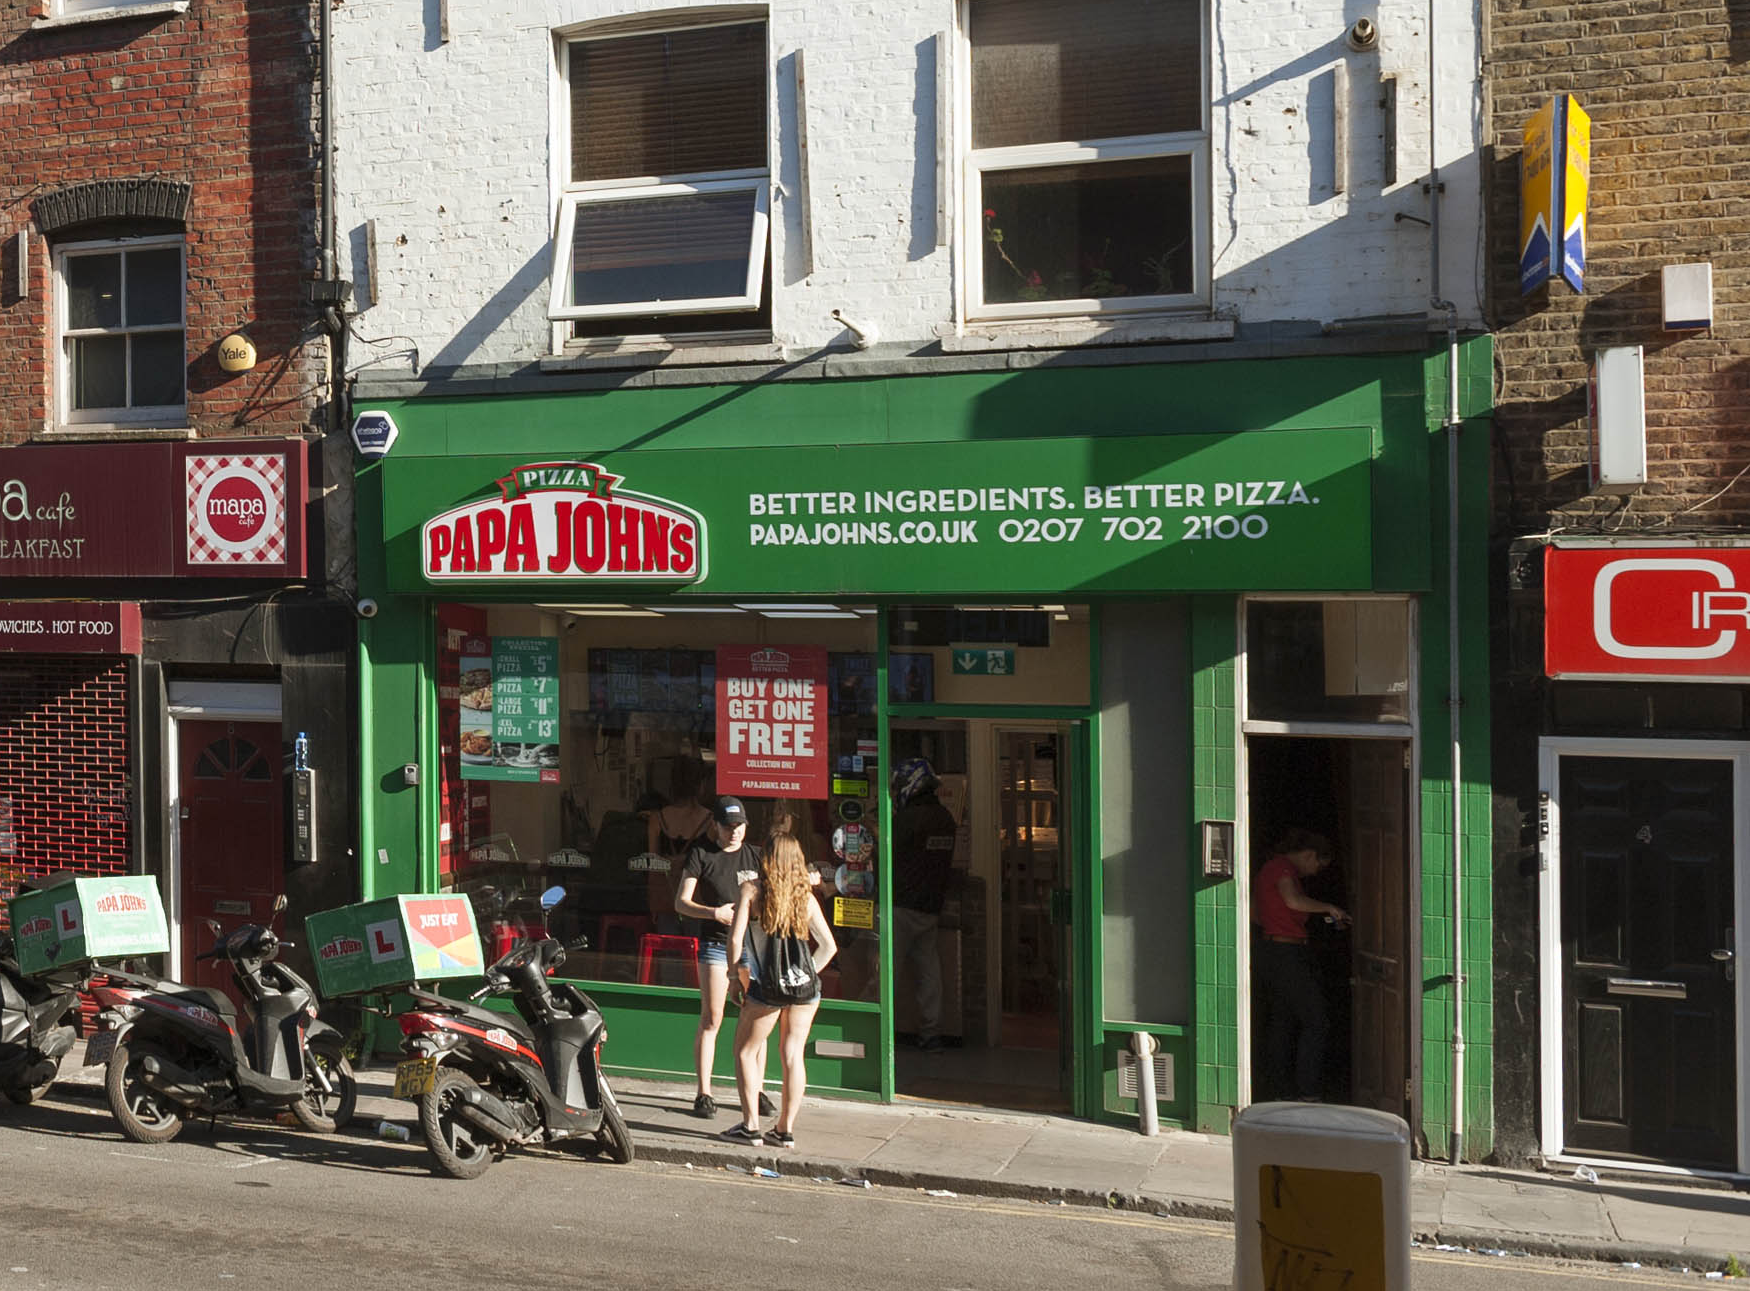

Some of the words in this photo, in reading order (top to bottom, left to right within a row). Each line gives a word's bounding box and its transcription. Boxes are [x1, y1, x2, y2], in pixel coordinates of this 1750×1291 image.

[522, 469, 591, 487] PIZZA
[750, 491, 856, 516] BETTER
[865, 487, 1075, 514] INGREDIENTS.
[1084, 484, 1205, 509] BETTER
[1215, 481, 1320, 507] PIZZA.
[209, 498, 265, 519] mapa
[430, 503, 540, 573] PAPA
[547, 501, 694, 573] JOHN'S
[750, 520, 978, 546] PAPAJOHNS.CO.UK
[999, 518, 1084, 543] 0207
[1101, 516, 1163, 542] 702
[1182, 514, 1269, 540] 2100
[52, 620, 76, 634] HOT
[79, 620, 114, 635] FOOD
[497, 663, 522, 673] PIZZA
[497, 683, 523, 693] PIZZA
[727, 677, 769, 698] BUY
[773, 678, 815, 699] ONE
[497, 705, 523, 715] PIZZA
[728, 699, 768, 719] GET
[772, 700, 814, 721] ONE
[497, 726, 523, 737] PIZZA
[729, 721, 815, 757] FREE
[746, 759, 781, 769] COLLECTION
[781, 761, 796, 770] ONLY
[97, 895, 120, 913] PAPA
[61, 908, 77, 932] L
[419, 914, 440, 929] JUST
[441, 912, 459, 926] EAT
[320, 943, 339, 959] PAPA
[374, 930, 395, 954] L
